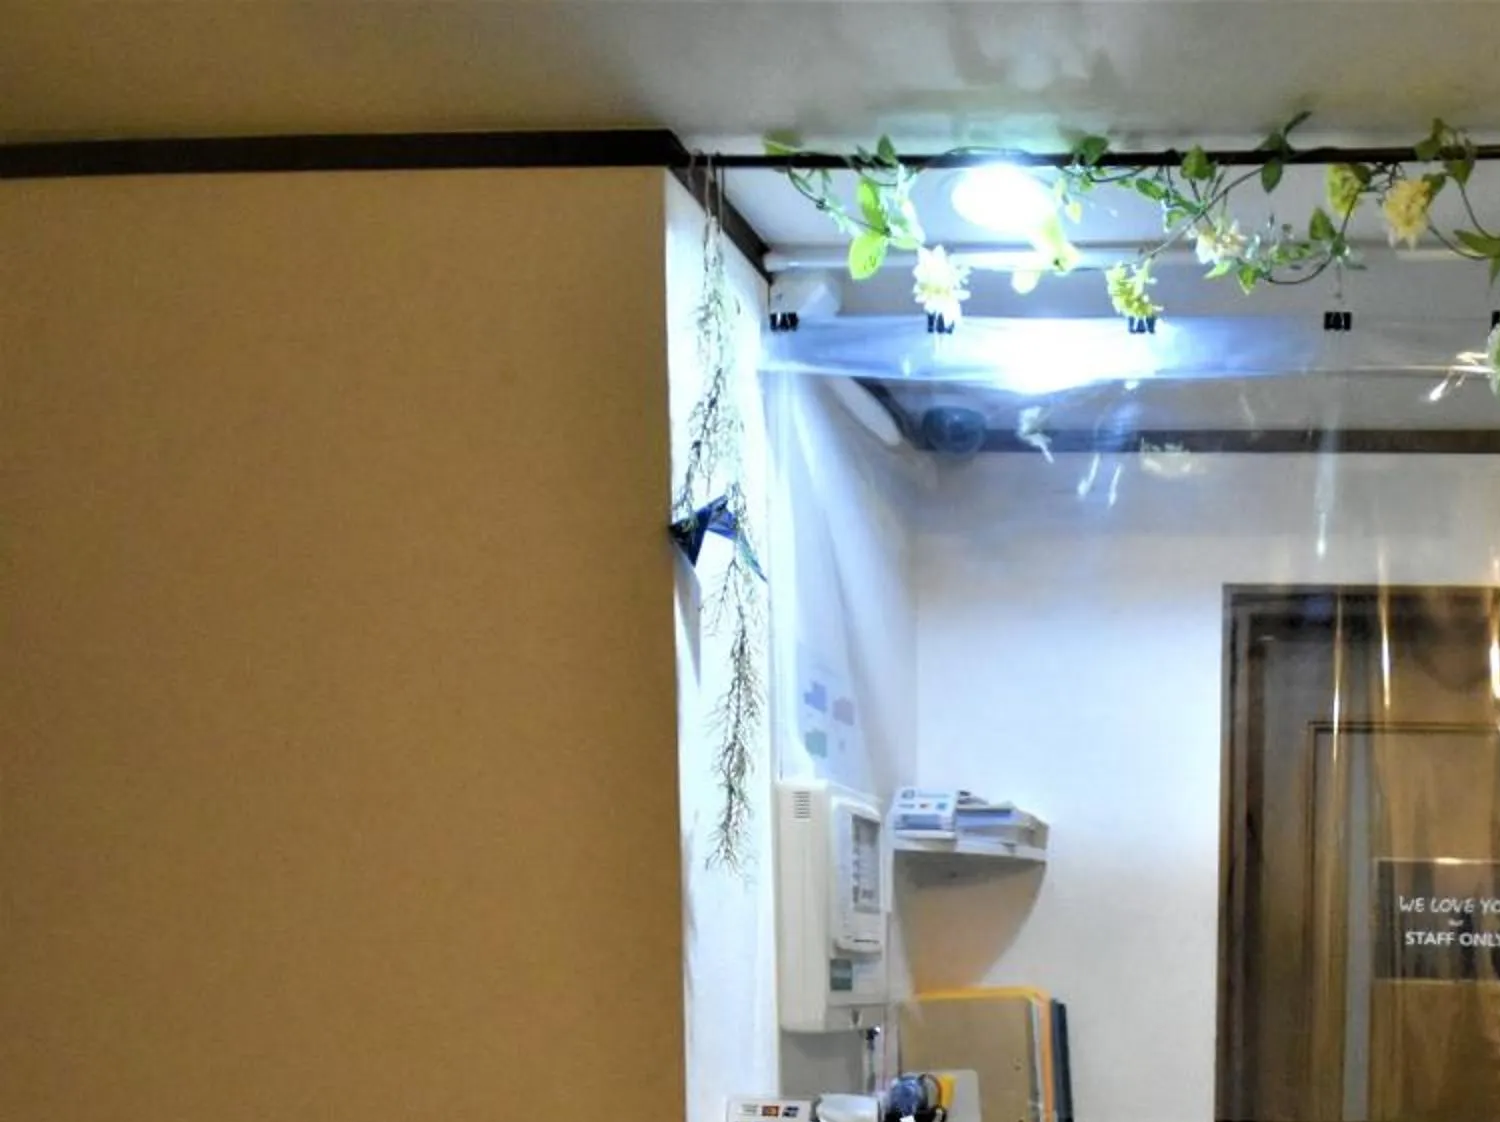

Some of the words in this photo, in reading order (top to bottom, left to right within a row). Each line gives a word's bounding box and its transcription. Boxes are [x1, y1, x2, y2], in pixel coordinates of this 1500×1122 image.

[1399, 896, 1425, 913] WE
[1430, 898, 1474, 914] LOVE
[1405, 932, 1455, 946] STAFF
